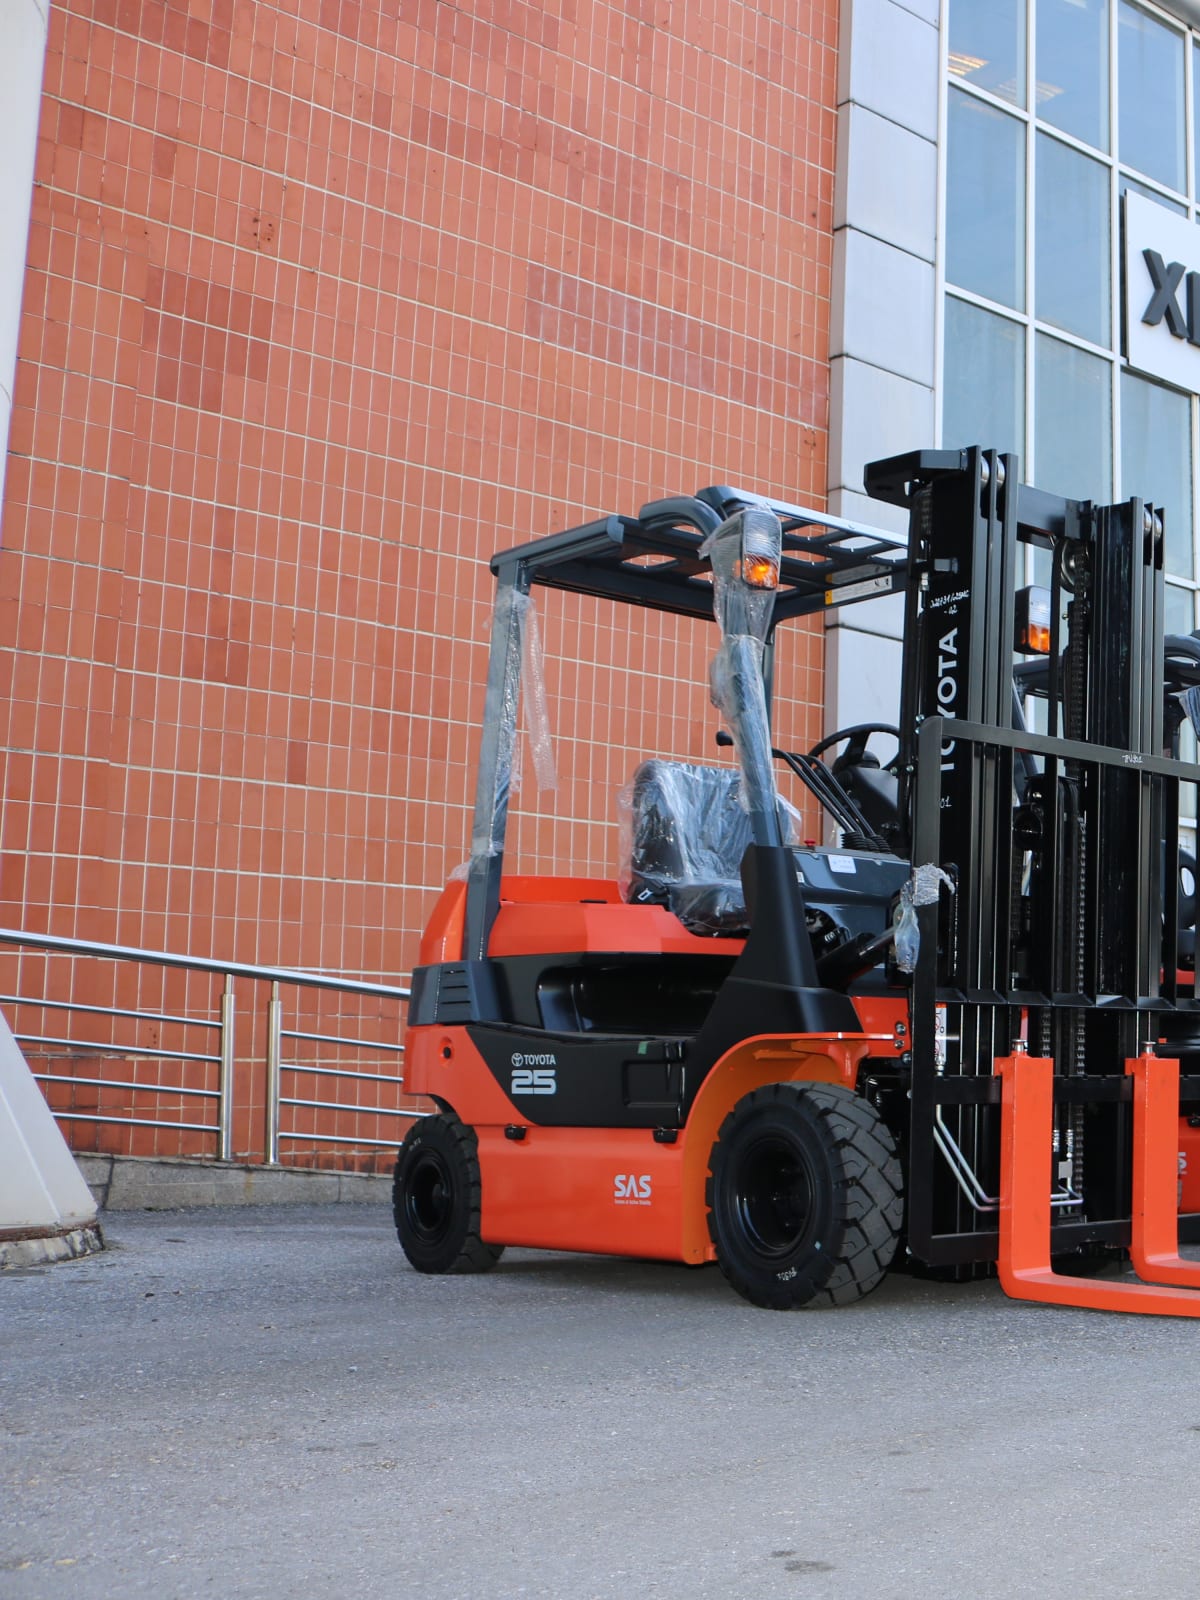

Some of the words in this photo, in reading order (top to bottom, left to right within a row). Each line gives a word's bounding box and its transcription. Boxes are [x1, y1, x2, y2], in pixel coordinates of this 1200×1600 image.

[523, 1054, 556, 1065] TOYOTA
[511, 1069, 557, 1095] 25
[614, 1174, 652, 1198] SAS
